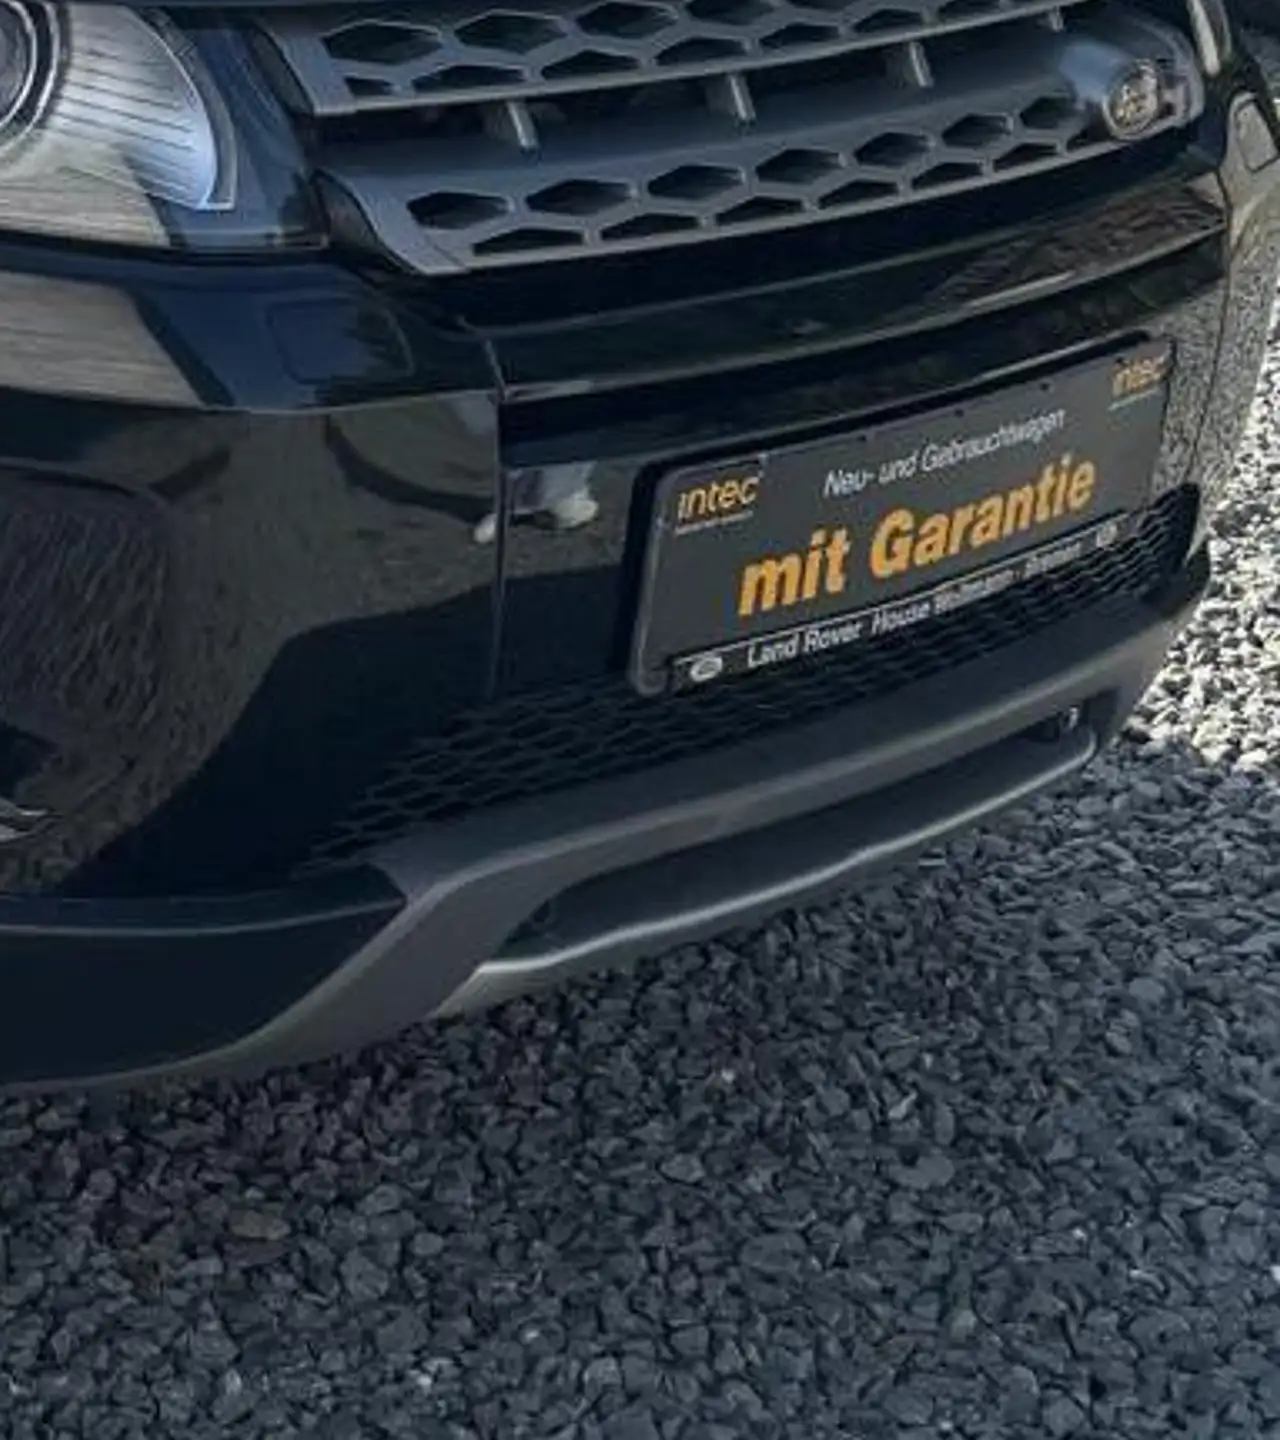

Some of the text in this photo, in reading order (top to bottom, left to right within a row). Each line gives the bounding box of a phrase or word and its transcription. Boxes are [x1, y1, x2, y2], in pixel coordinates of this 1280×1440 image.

[824, 409, 1066, 498] Neu- und Gebrauchtwagen
[677, 475, 761, 518] intec
[738, 528, 850, 615] mit
[871, 453, 1096, 579] Garantie
[746, 628, 797, 669] Land
[803, 623, 860, 655] Rover
